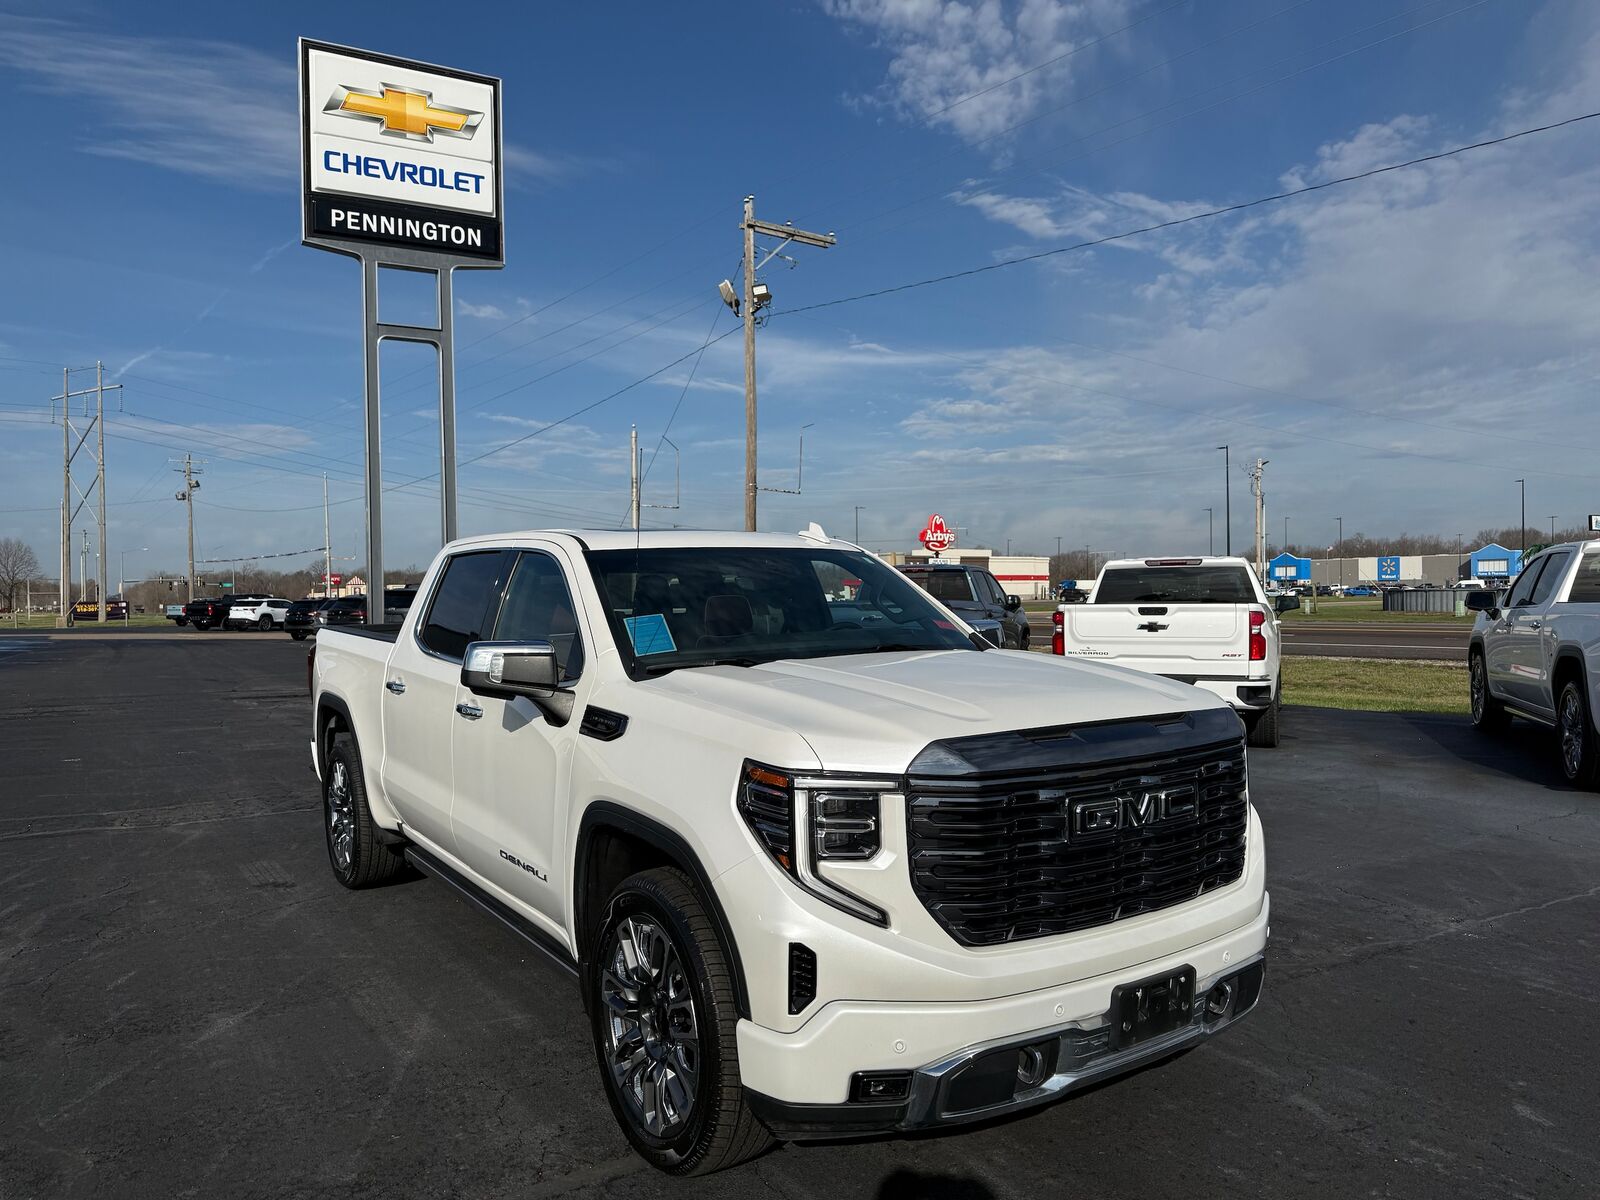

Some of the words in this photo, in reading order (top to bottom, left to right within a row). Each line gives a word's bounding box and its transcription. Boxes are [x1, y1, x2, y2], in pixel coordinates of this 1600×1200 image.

[323, 150, 485, 194] CHEVROLET
[330, 208, 482, 247] PENNINGTON
[925, 529, 955, 544] Arby's
[1074, 785, 1196, 835] GMC
[499, 849, 548, 883] DENALI
